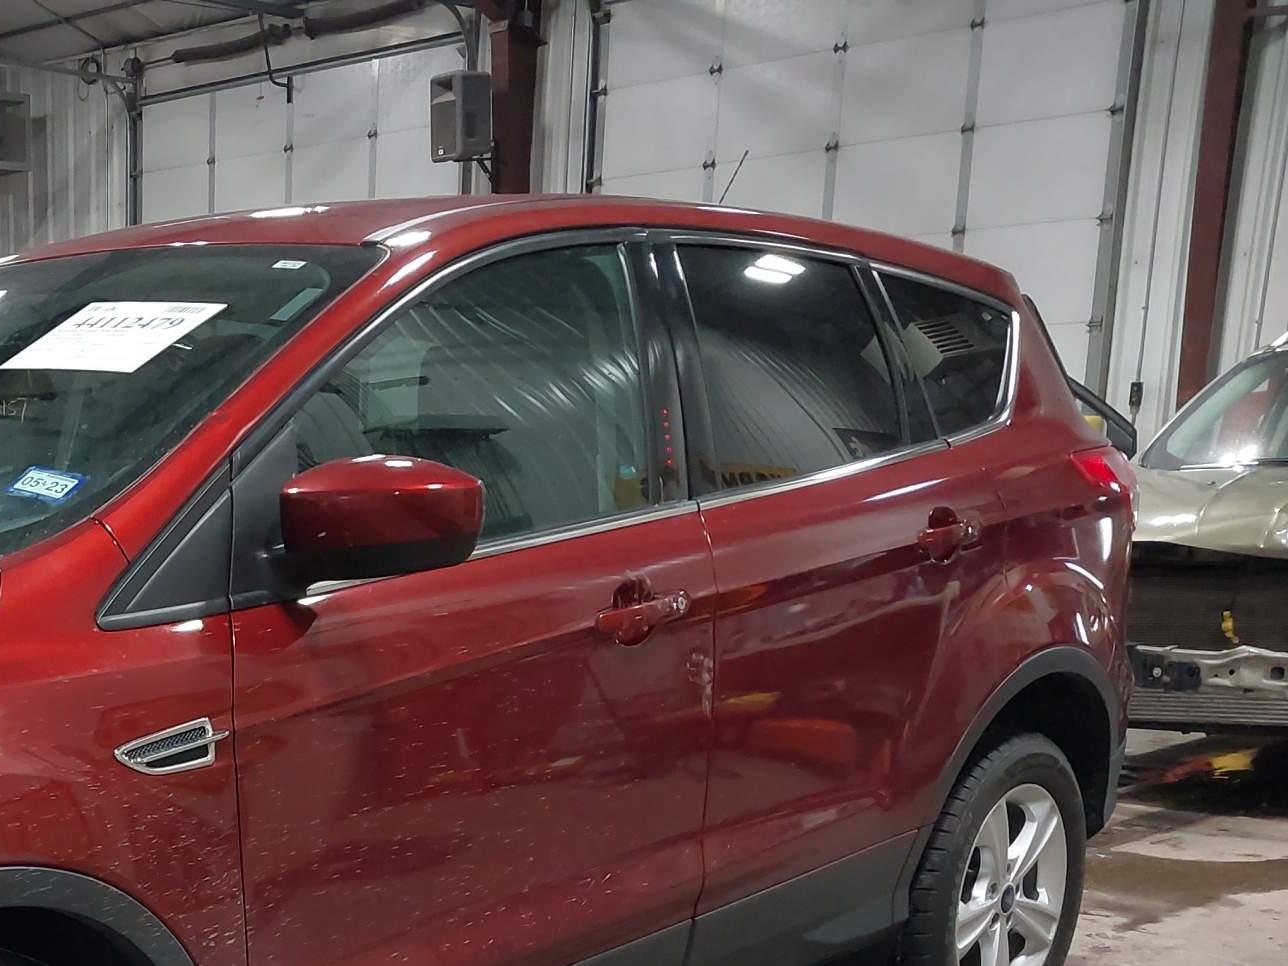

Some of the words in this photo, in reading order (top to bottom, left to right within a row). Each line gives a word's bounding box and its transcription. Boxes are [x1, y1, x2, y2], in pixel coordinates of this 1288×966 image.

[73, 316, 186, 329] 44112479
[21, 476, 44, 487] 05
[45, 481, 68, 494] 23
